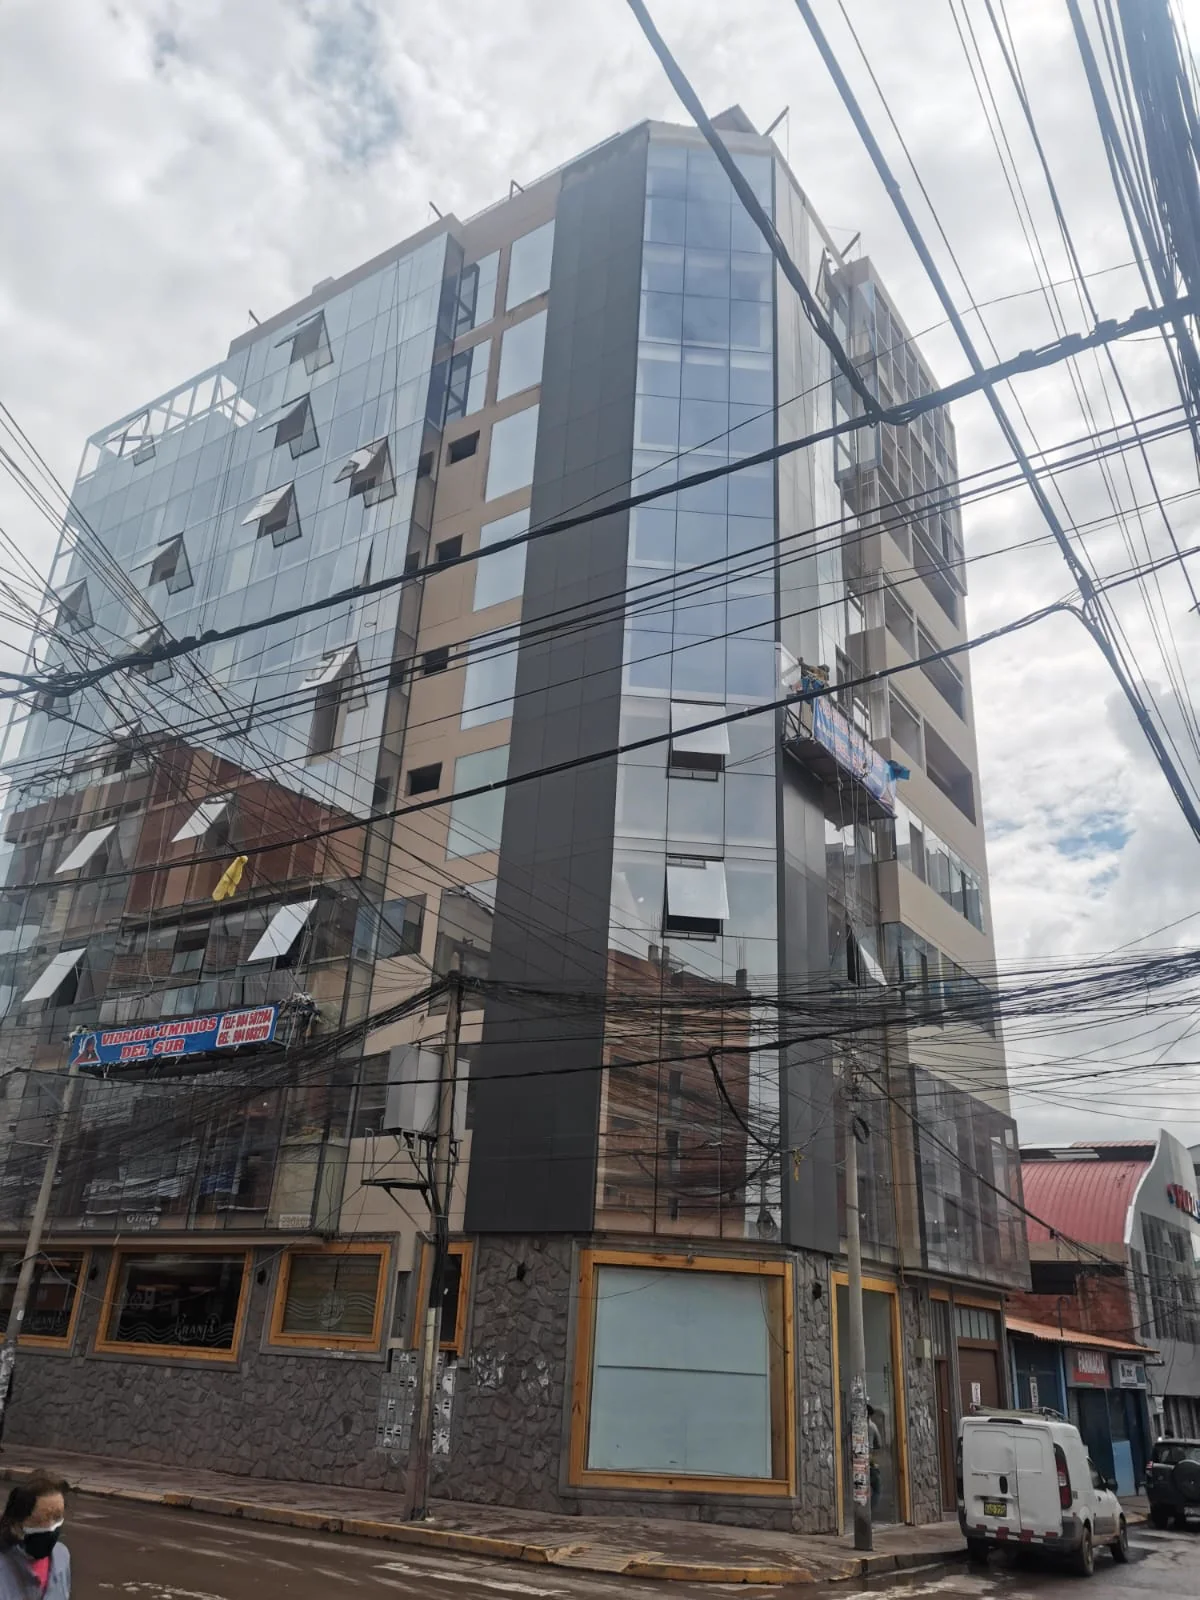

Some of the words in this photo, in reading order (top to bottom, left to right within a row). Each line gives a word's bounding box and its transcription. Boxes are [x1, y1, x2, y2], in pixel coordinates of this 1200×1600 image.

[101, 1017, 218, 1046] VIDRIOALUMINIOS
[121, 1044, 149, 1059] DEL
[153, 1039, 185, 1055] SUR
